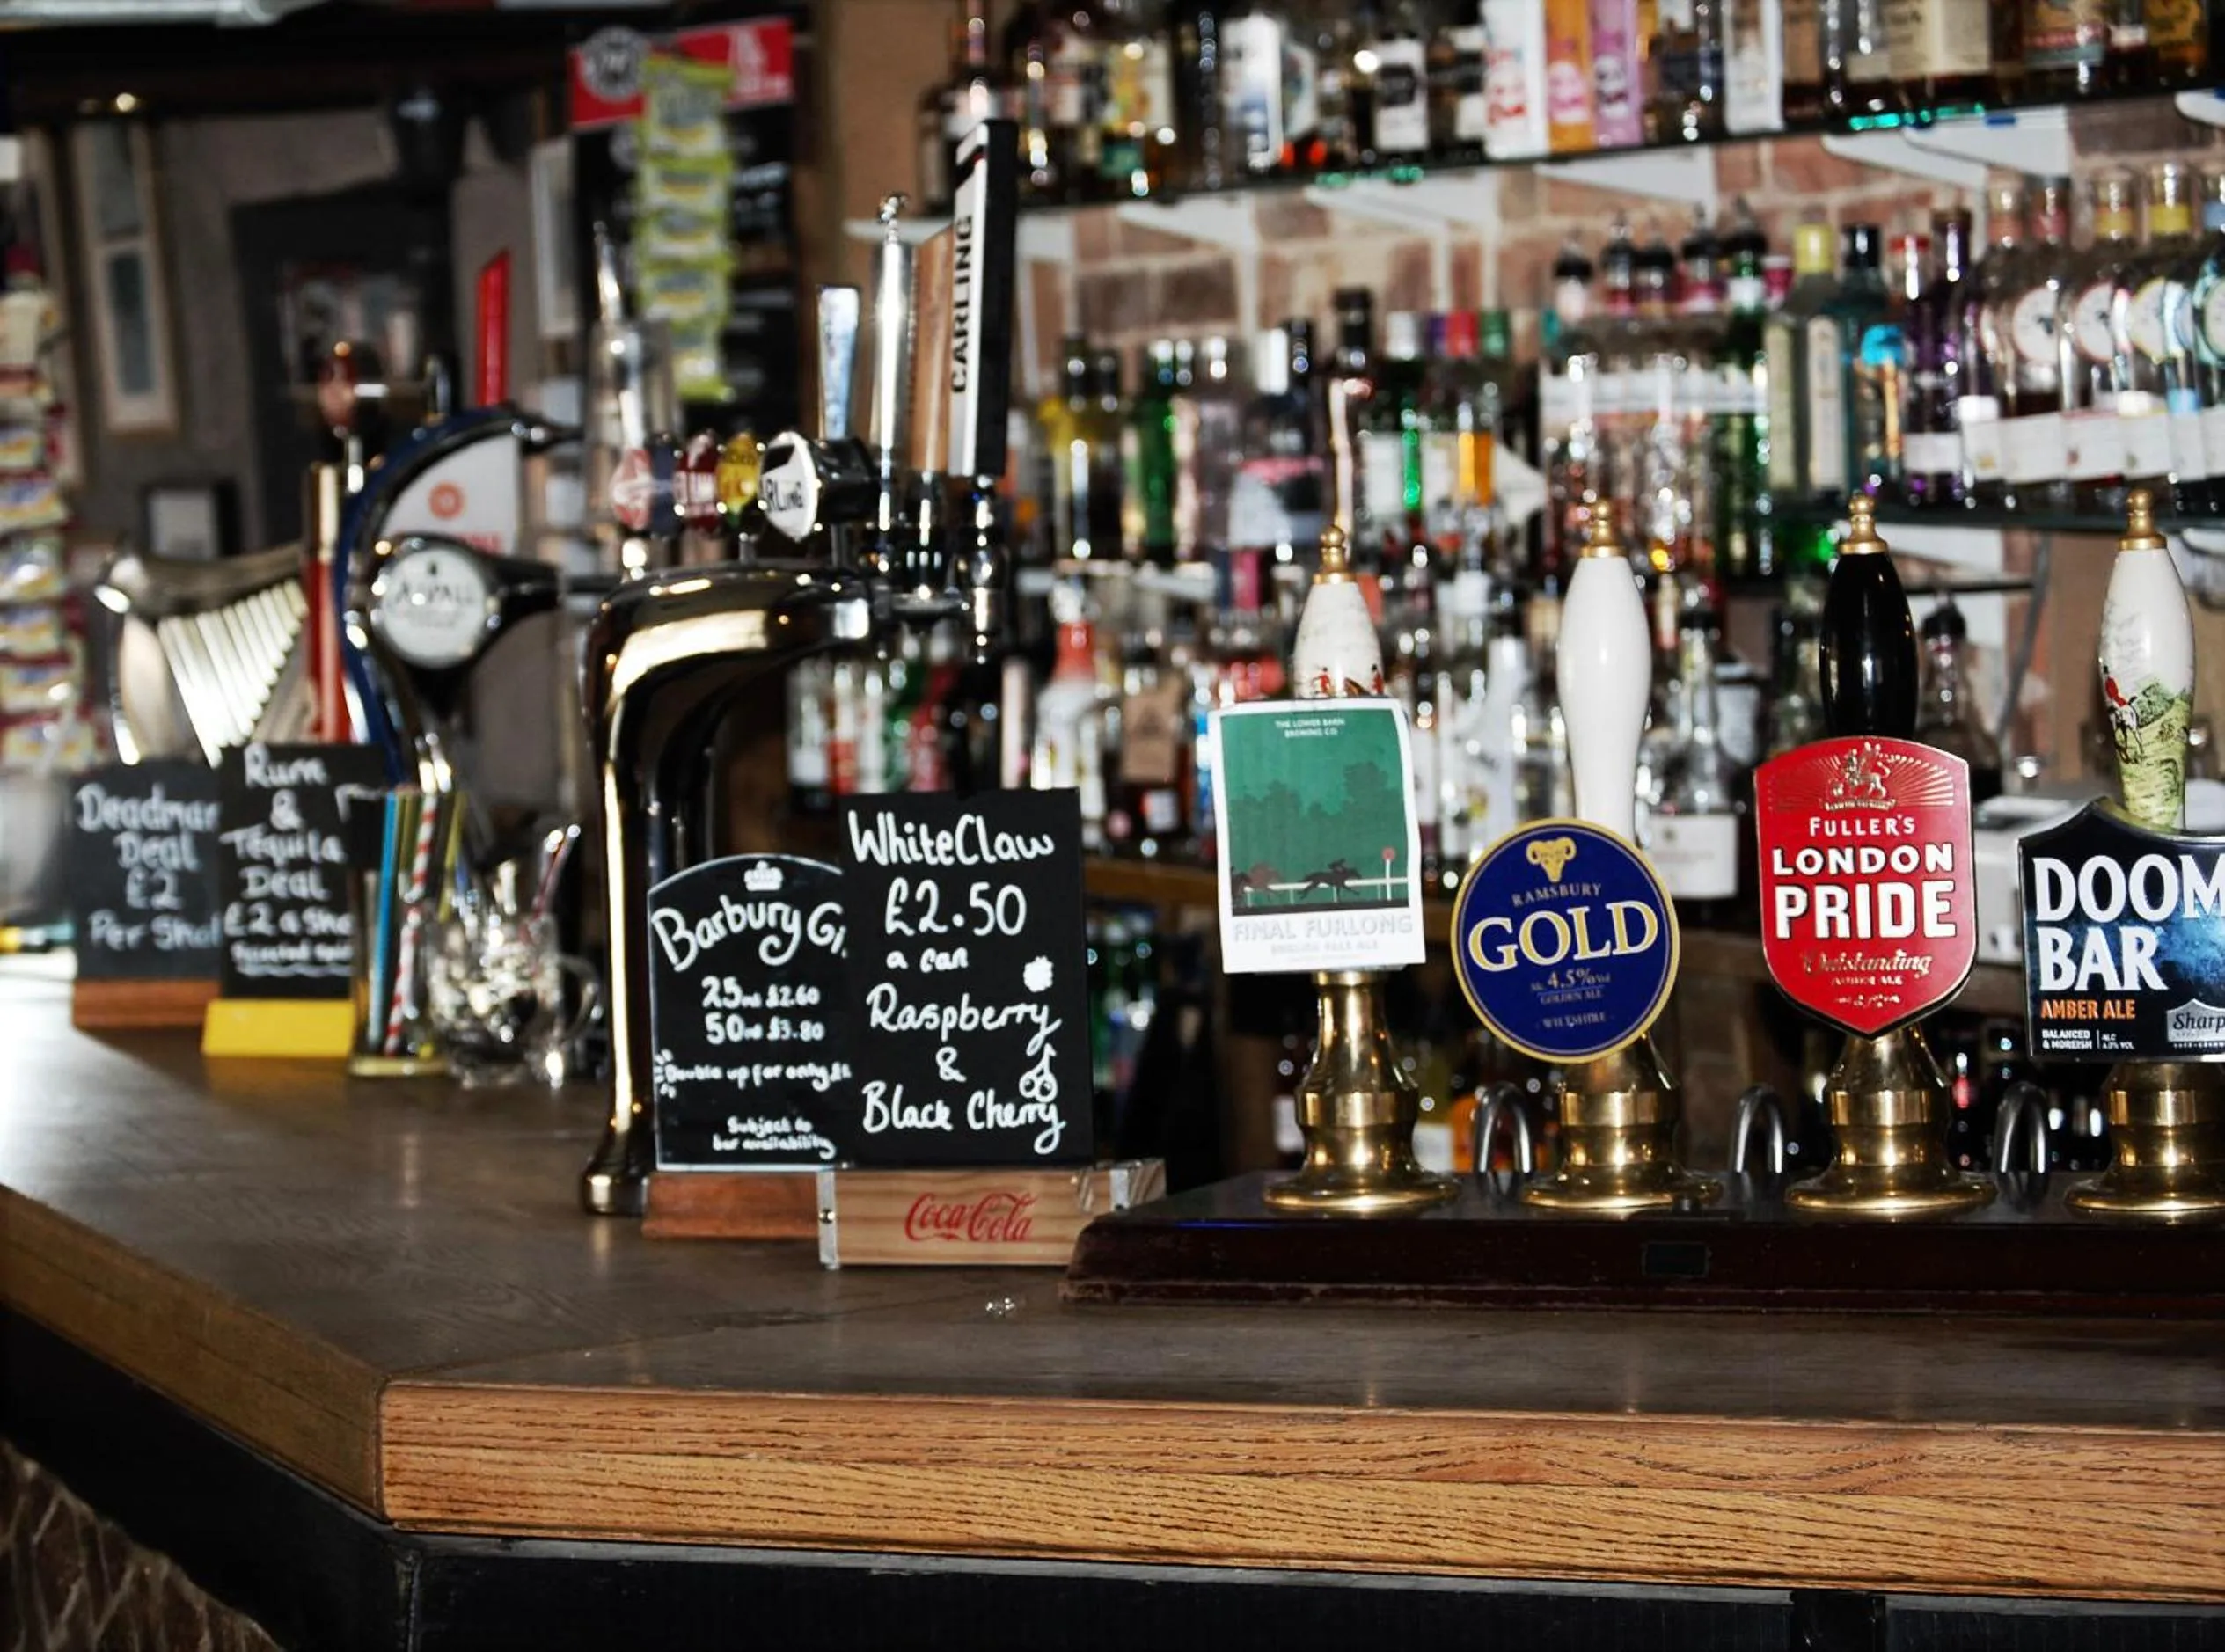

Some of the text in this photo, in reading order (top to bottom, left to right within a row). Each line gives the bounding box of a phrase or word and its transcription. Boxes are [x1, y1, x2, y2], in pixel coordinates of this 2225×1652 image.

[950, 216, 972, 393] CARLING
[243, 742, 328, 787] Rum
[270, 790, 302, 830] &
[1809, 814, 1916, 837] FULLER'S
[113, 830, 203, 872] Deal
[219, 823, 346, 867] Tequila
[1772, 842, 1955, 876] LONDON
[238, 866, 330, 901] Deal
[1511, 882, 1602, 908] RAMSBURY
[2032, 853, 2225, 923] DOOM
[302, 907, 354, 937] Sho
[885, 877, 1028, 936] £2.50
[1775, 880, 1958, 939] PRIDE
[88, 909, 148, 951] Per
[650, 894, 801, 972] Barbury
[1233, 914, 1413, 942] FINAL FURLONG
[1468, 900, 1659, 972] GOLD
[886, 947, 969, 973] a can
[2036, 925, 2170, 991] BAR
[866, 983, 1062, 1056] Raspberry
[2040, 998, 2136, 1020] AMBER ALE
[2041, 1028, 2090, 1039] BALANCED
[727, 1064, 750, 1090] up
[752, 1063, 782, 1087] for
[935, 1046, 966, 1083] &
[861, 1080, 1067, 1155] Black Cherry
